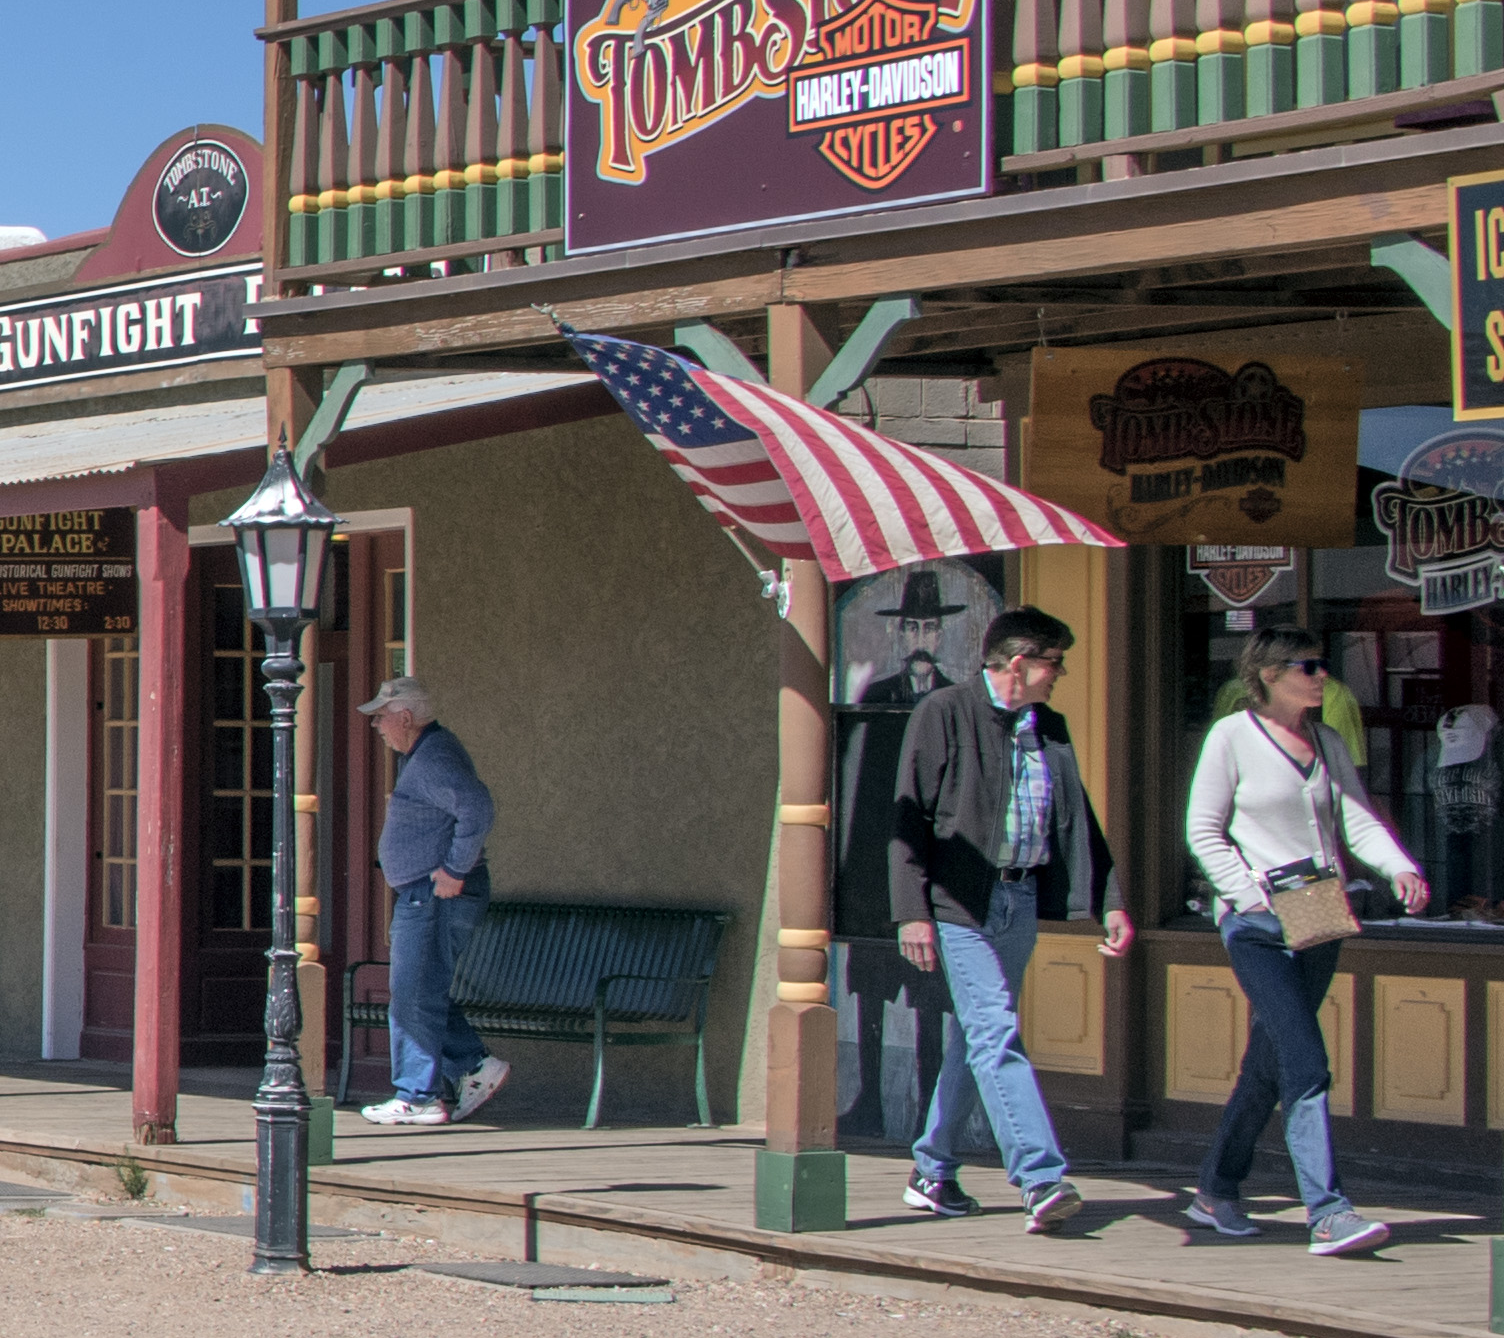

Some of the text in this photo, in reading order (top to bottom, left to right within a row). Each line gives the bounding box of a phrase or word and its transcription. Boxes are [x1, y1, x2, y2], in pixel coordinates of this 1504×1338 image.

[835, 4, 926, 59] MOTOR
[796, 50, 962, 122] HARLEY-DAVIDSON
[835, 114, 922, 179] CYCLES
[163, 149, 239, 193] TOMBSTONE
[1, 534, 96, 554] PALACE
[39, 581, 106, 596] THEATRE
[51, 564, 99, 579] GUNFIGHT
[102, 564, 133, 579] SHOWS
